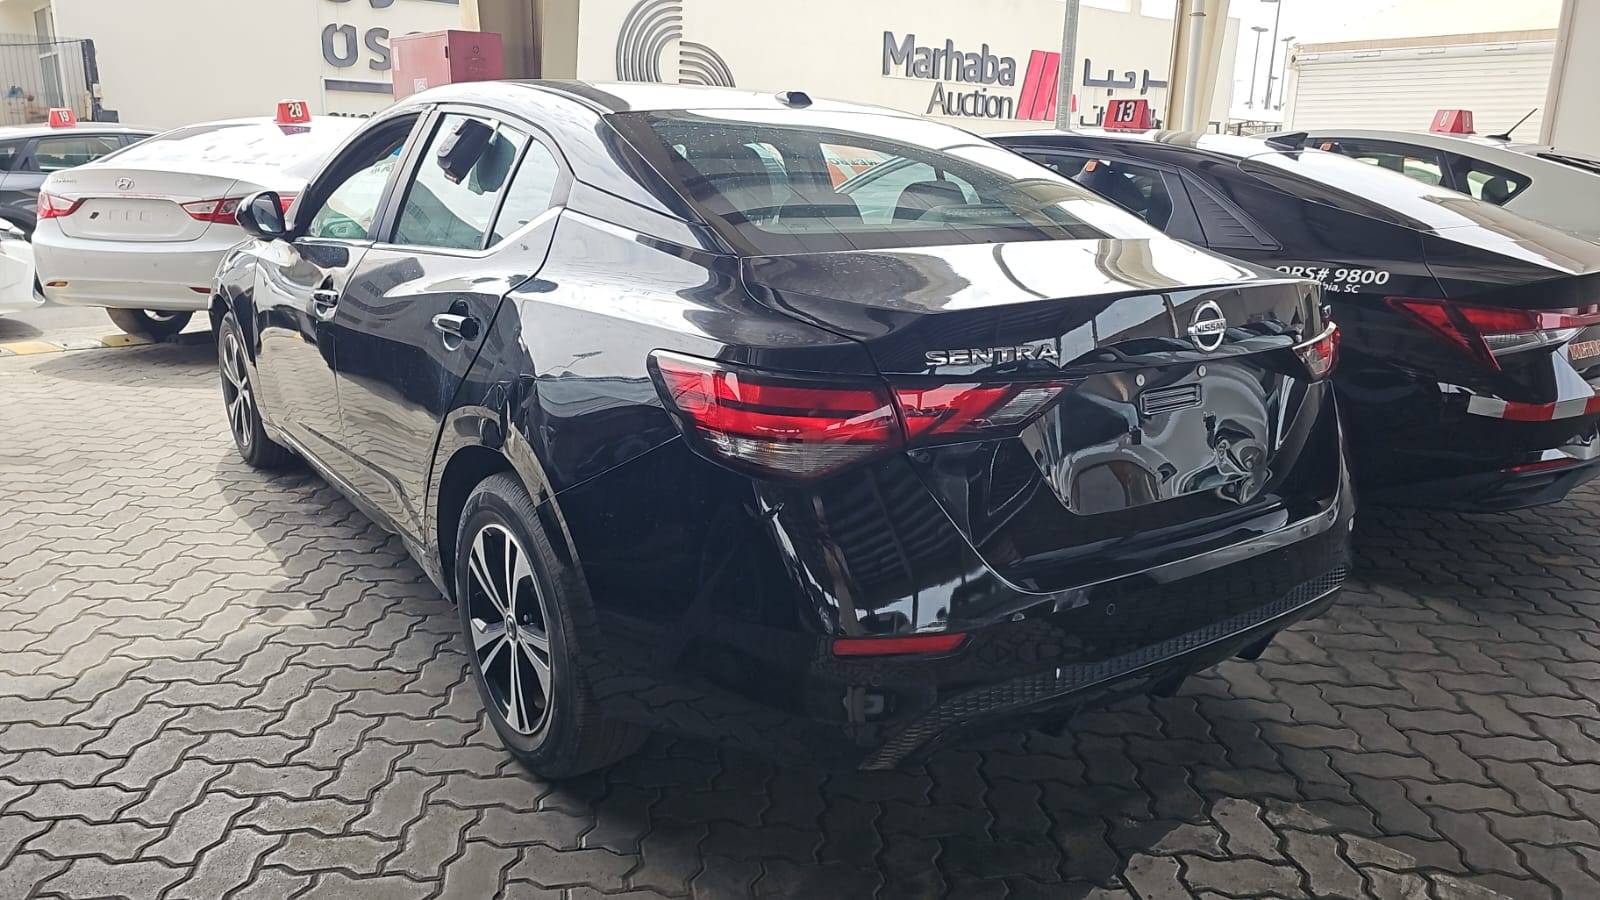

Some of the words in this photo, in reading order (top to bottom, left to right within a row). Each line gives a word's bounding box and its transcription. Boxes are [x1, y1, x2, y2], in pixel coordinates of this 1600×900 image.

[882, 30, 1017, 86] Marhaba
[287, 102, 303, 118] 28
[925, 81, 1014, 120] Auction
[1116, 101, 1136, 123] 13
[1333, 268, 1391, 285] 9800
[1322, 281, 1341, 293] bia,
[1343, 283, 1361, 294] SC
[1194, 321, 1225, 333] NISSAN
[924, 343, 1060, 367] SENTRA
